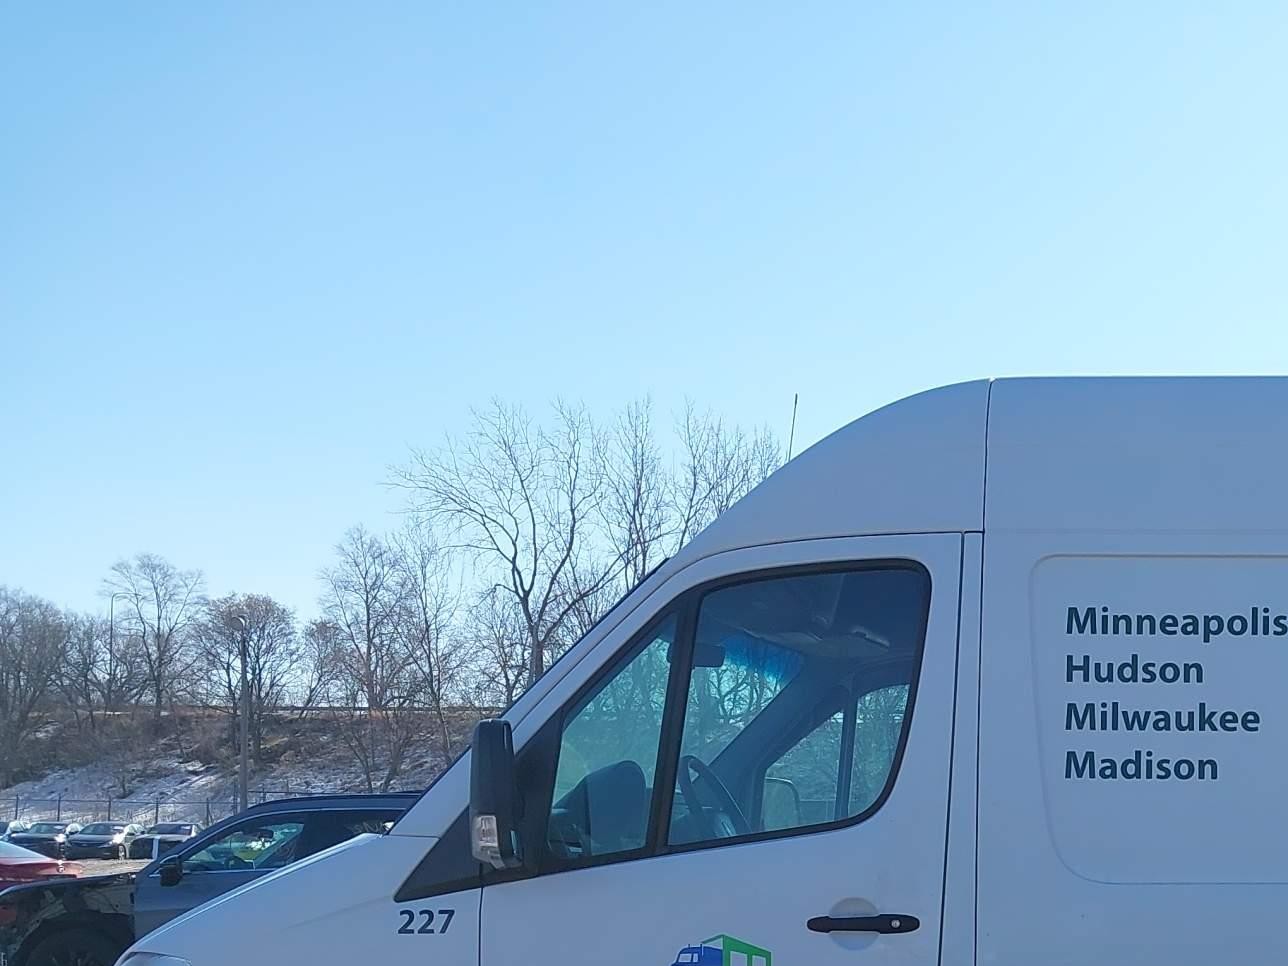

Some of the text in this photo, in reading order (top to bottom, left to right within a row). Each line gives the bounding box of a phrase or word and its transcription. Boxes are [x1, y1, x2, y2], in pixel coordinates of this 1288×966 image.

[1066, 606, 1288, 643] Minneapolis
[1065, 654, 1204, 683] Hudson
[1065, 702, 1261, 732] Milwaukee
[1065, 750, 1218, 780] Madison
[398, 909, 455, 934] 227
